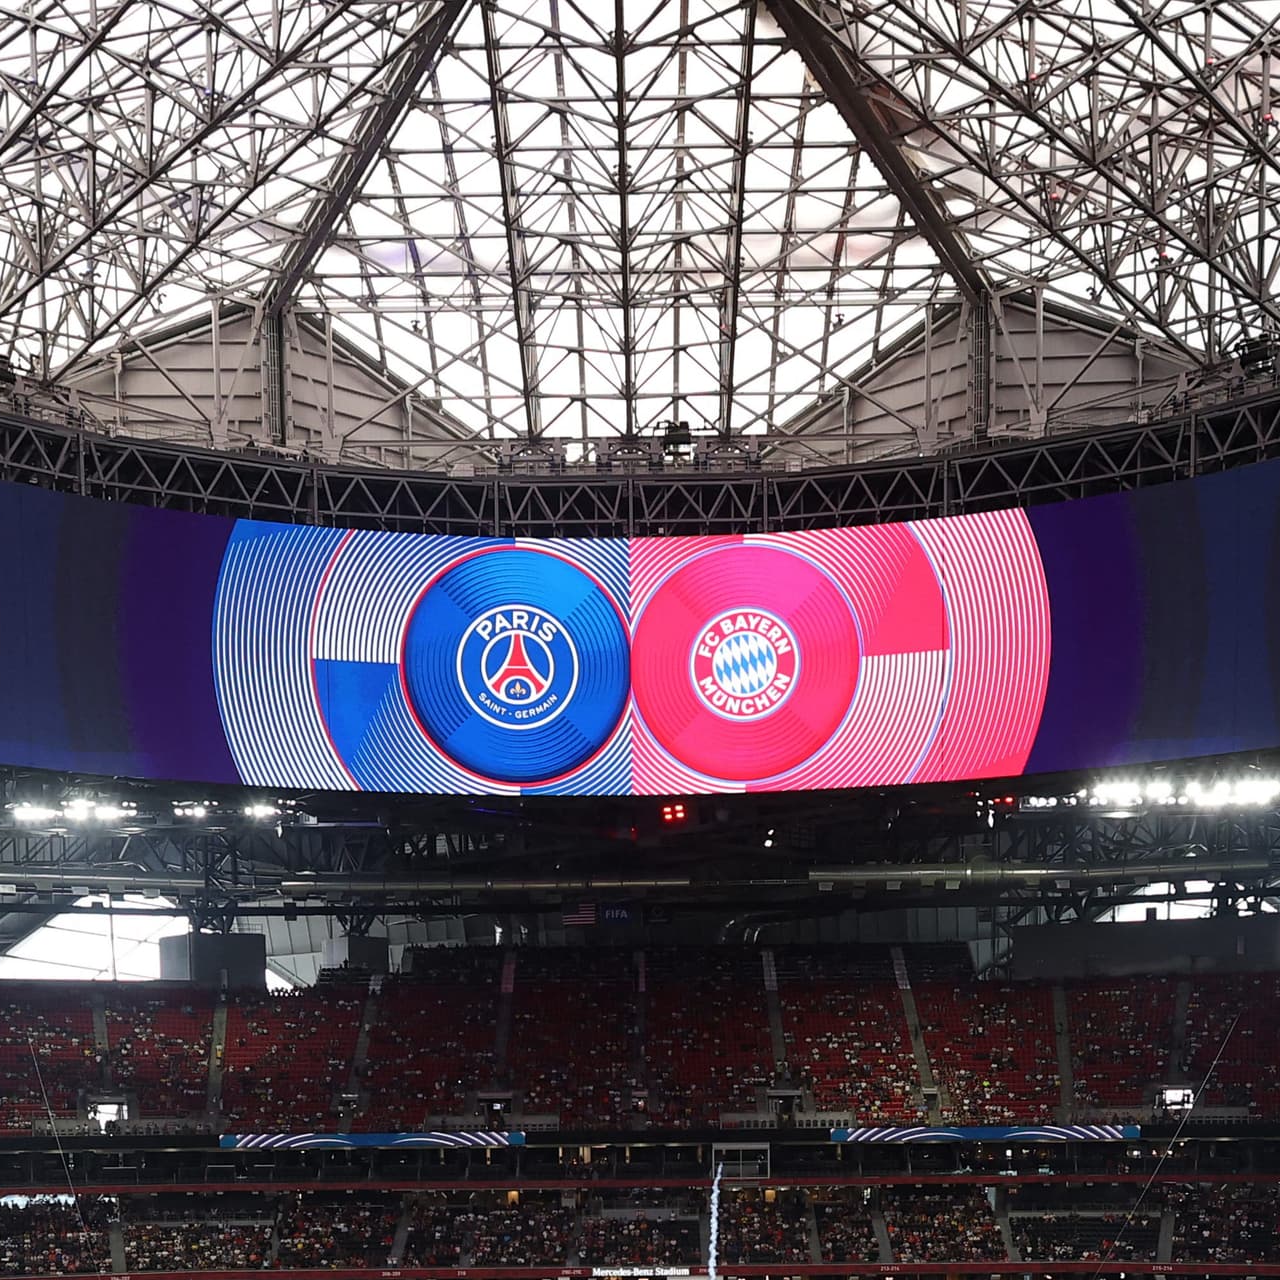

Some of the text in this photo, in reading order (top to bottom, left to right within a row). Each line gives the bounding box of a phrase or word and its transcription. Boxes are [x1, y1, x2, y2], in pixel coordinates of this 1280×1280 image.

[475, 611, 558, 642] PARIS
[698, 614, 791, 658] FC BAYERN
[478, 692, 558, 718] SAINT GERMAIN
[699, 673, 791, 714] MÜNCHEN
[605, 909, 628, 919] FIFA
[592, 1267, 654, 1276] Mercedes-Benz
[655, 1267, 690, 1276] Stadium
